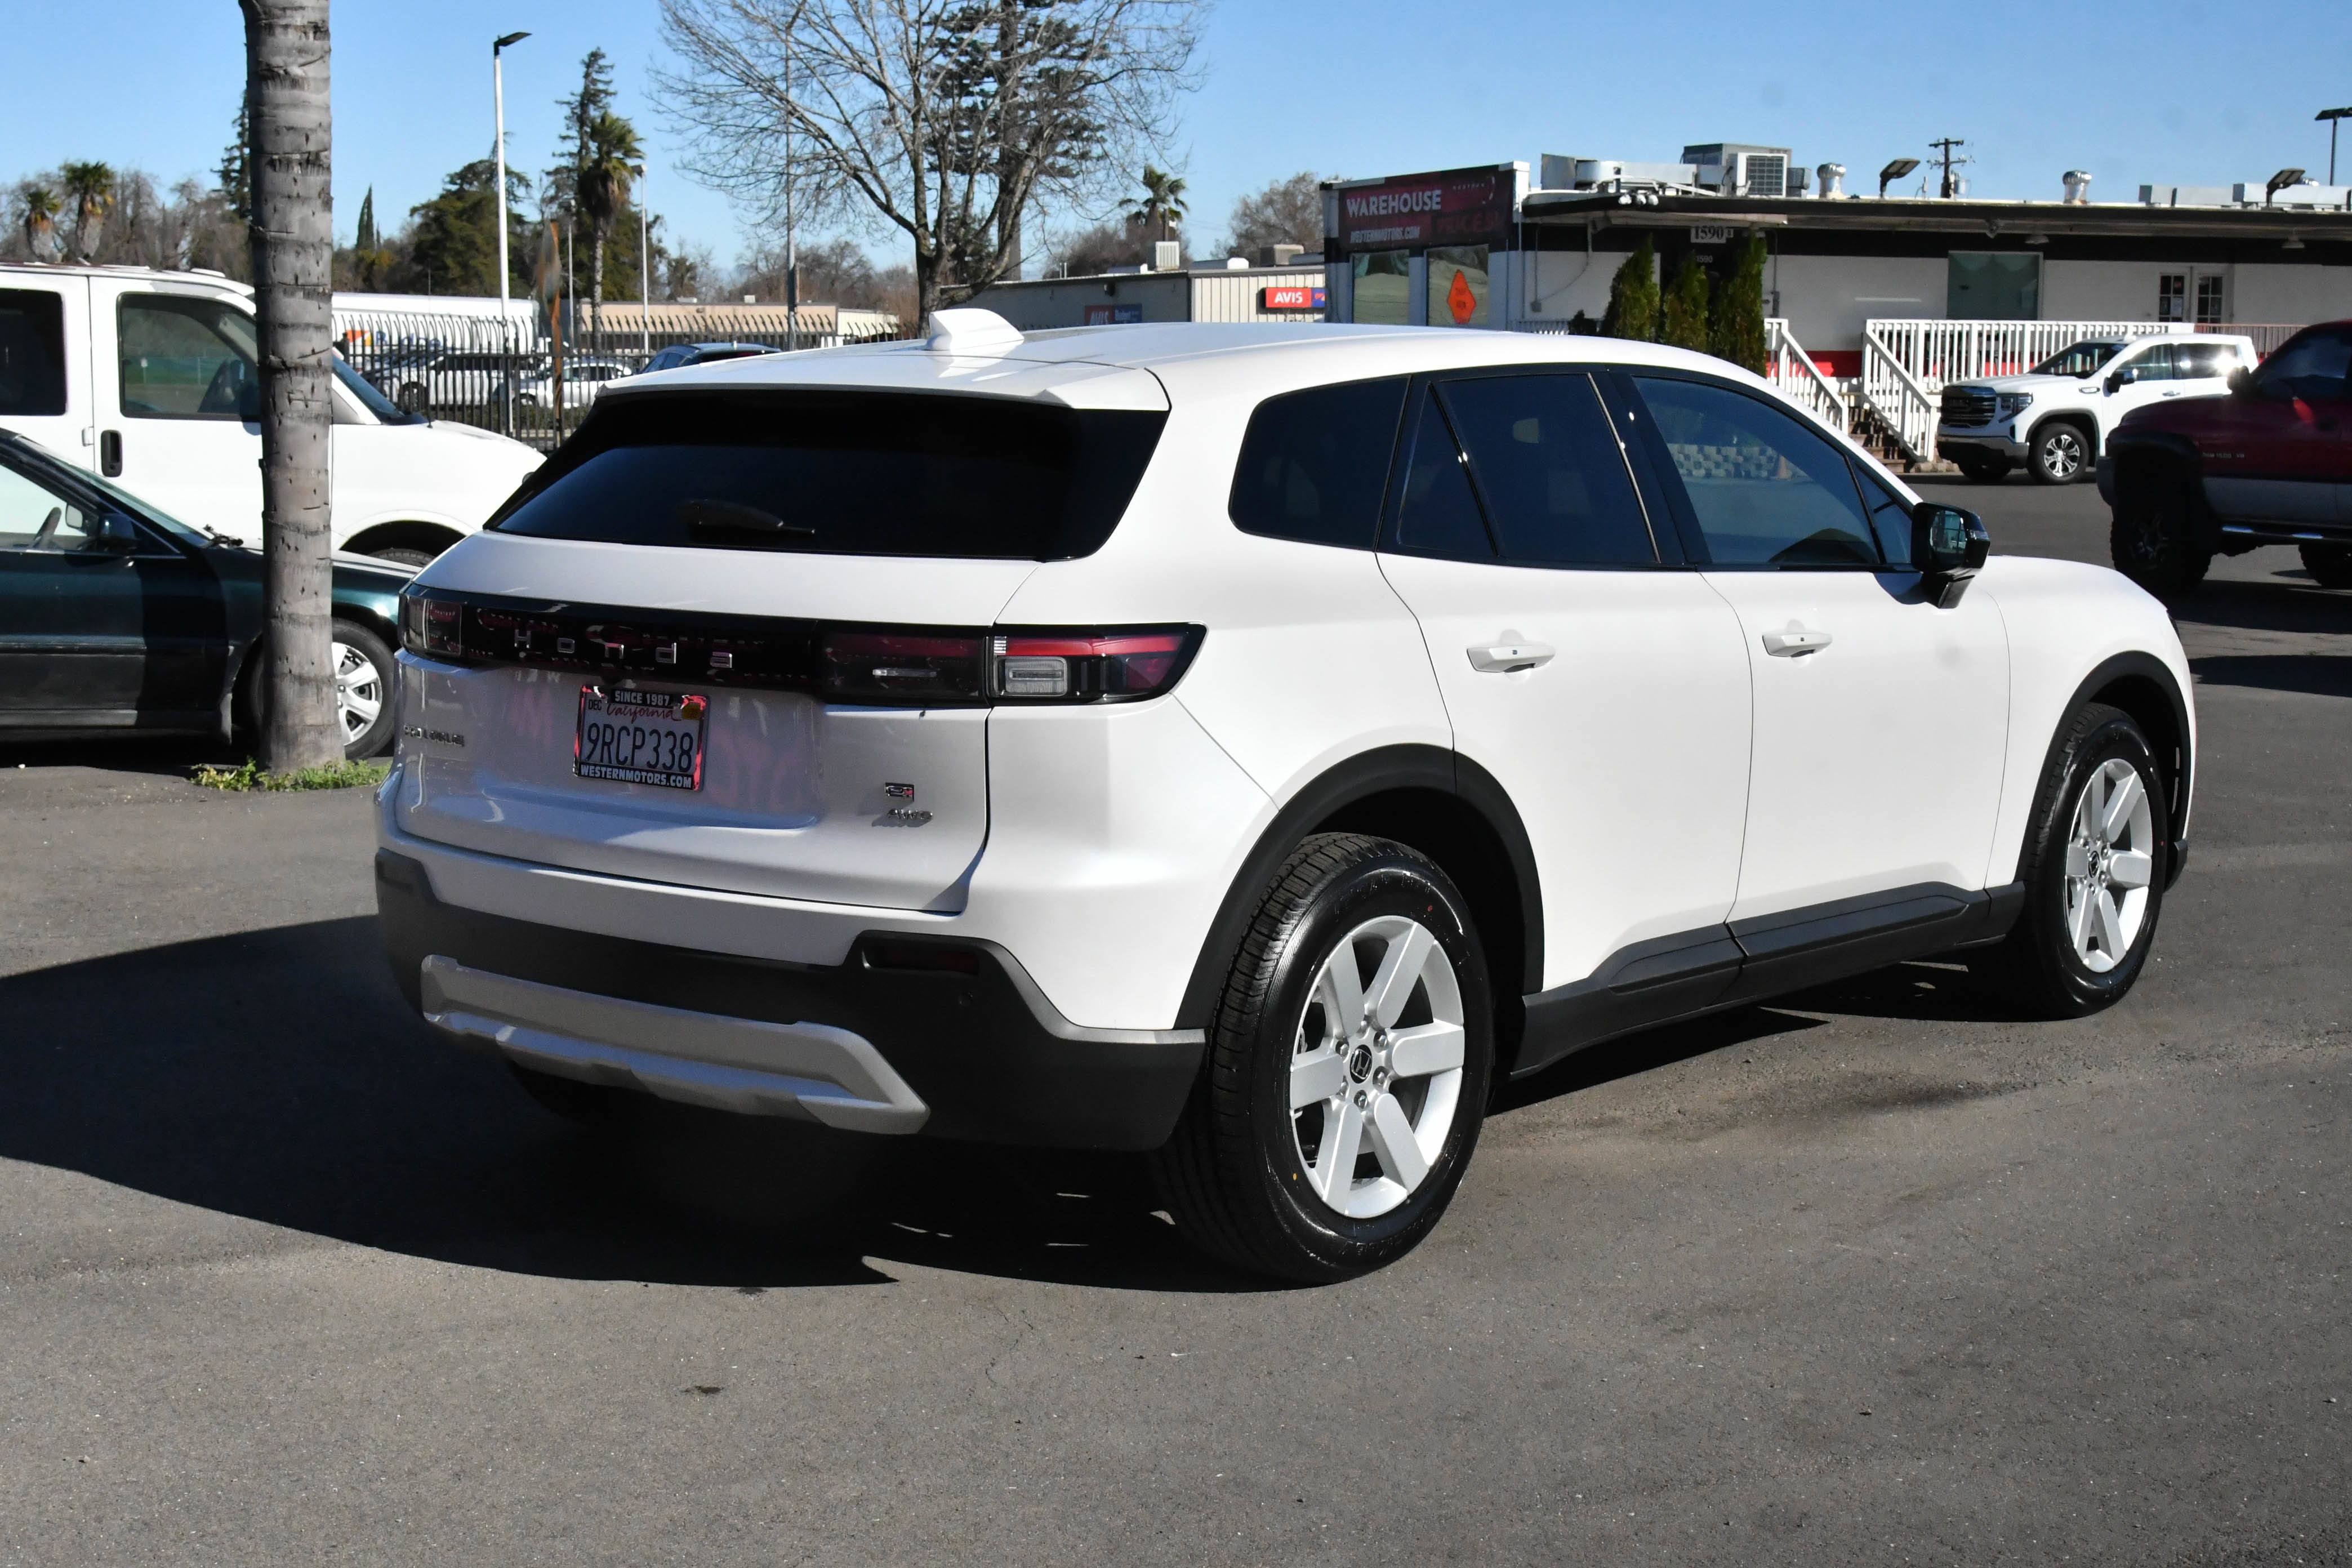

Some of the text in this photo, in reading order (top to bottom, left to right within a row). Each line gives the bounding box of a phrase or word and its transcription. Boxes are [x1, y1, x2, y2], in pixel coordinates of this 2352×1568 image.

[1347, 189, 1442, 218] WAREHOUSE
[1695, 226, 1723, 239] 1590
[1275, 291, 1303, 304] AVIS
[588, 699, 602, 711] DEC
[614, 691, 670, 706] SINCE 1987
[607, 703, 681, 723] California
[585, 722, 693, 773] 9RCP338
[581, 764, 692, 789] WESTERNMOTORS.COM
